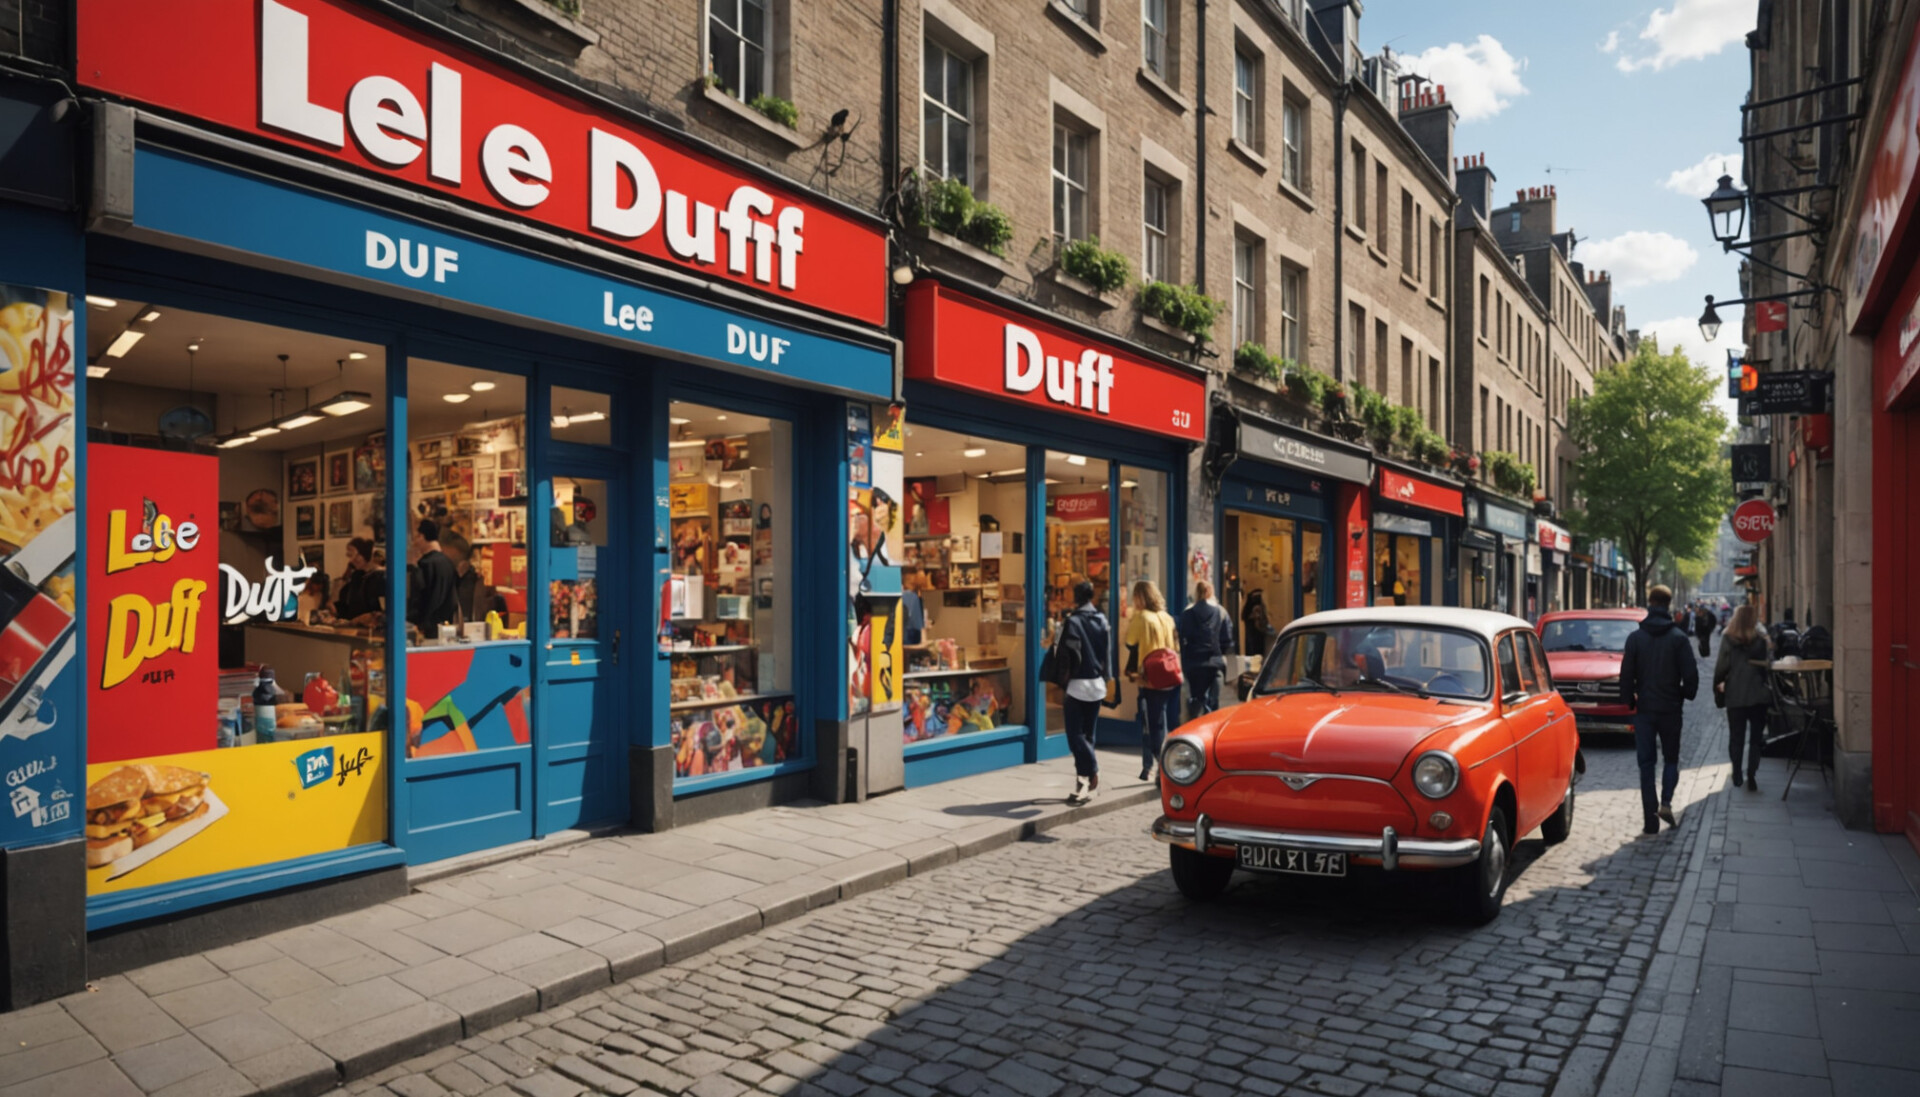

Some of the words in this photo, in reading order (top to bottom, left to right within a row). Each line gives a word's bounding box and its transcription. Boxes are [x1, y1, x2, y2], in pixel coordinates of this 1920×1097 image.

[365, 229, 458, 283] DUF
[604, 291, 653, 332] Lee
[727, 323, 791, 365] DUF
[1005, 323, 1114, 413] Duff
[102, 578, 207, 690] Duff
